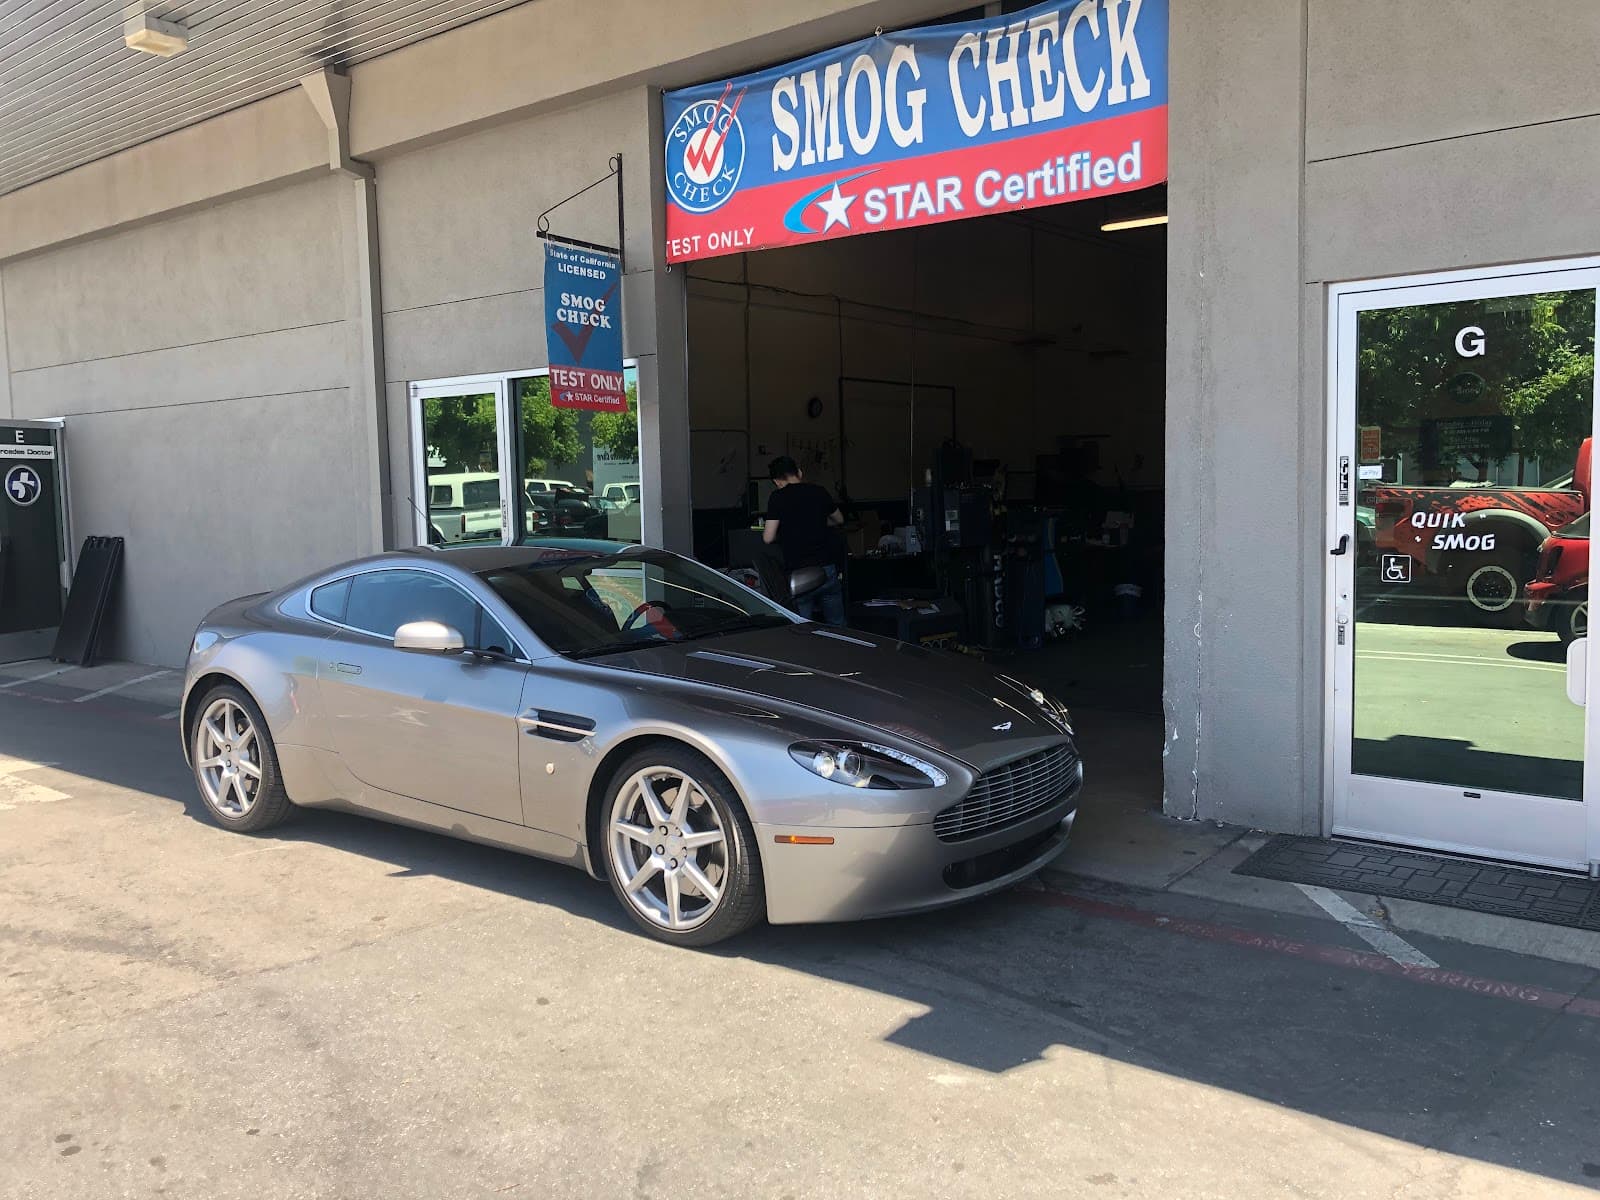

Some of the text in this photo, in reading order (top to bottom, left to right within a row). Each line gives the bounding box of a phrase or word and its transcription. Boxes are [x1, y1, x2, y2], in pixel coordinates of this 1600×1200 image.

[771, 0, 1151, 172] SMOG CHECK
[674, 104, 734, 143] SMOG
[674, 163, 736, 203] CHECK
[863, 140, 1142, 224] STAR Certified
[707, 227, 755, 250] ONLY
[558, 262, 606, 280] LICENSED
[570, 254, 578, 262] of
[580, 255, 616, 269] California
[560, 292, 606, 312] SMOG
[556, 308, 612, 329] CHECK
[1455, 326, 1485, 357] G
[551, 368, 623, 392] TEST ONLY
[574, 392, 620, 405] STAR Certified
[15, 430, 25, 443] E
[27, 448, 53, 456] Doctor
[1340, 459, 1348, 491] PULL
[1411, 511, 1467, 529] QUIK
[1431, 533, 1496, 551] SMOG
